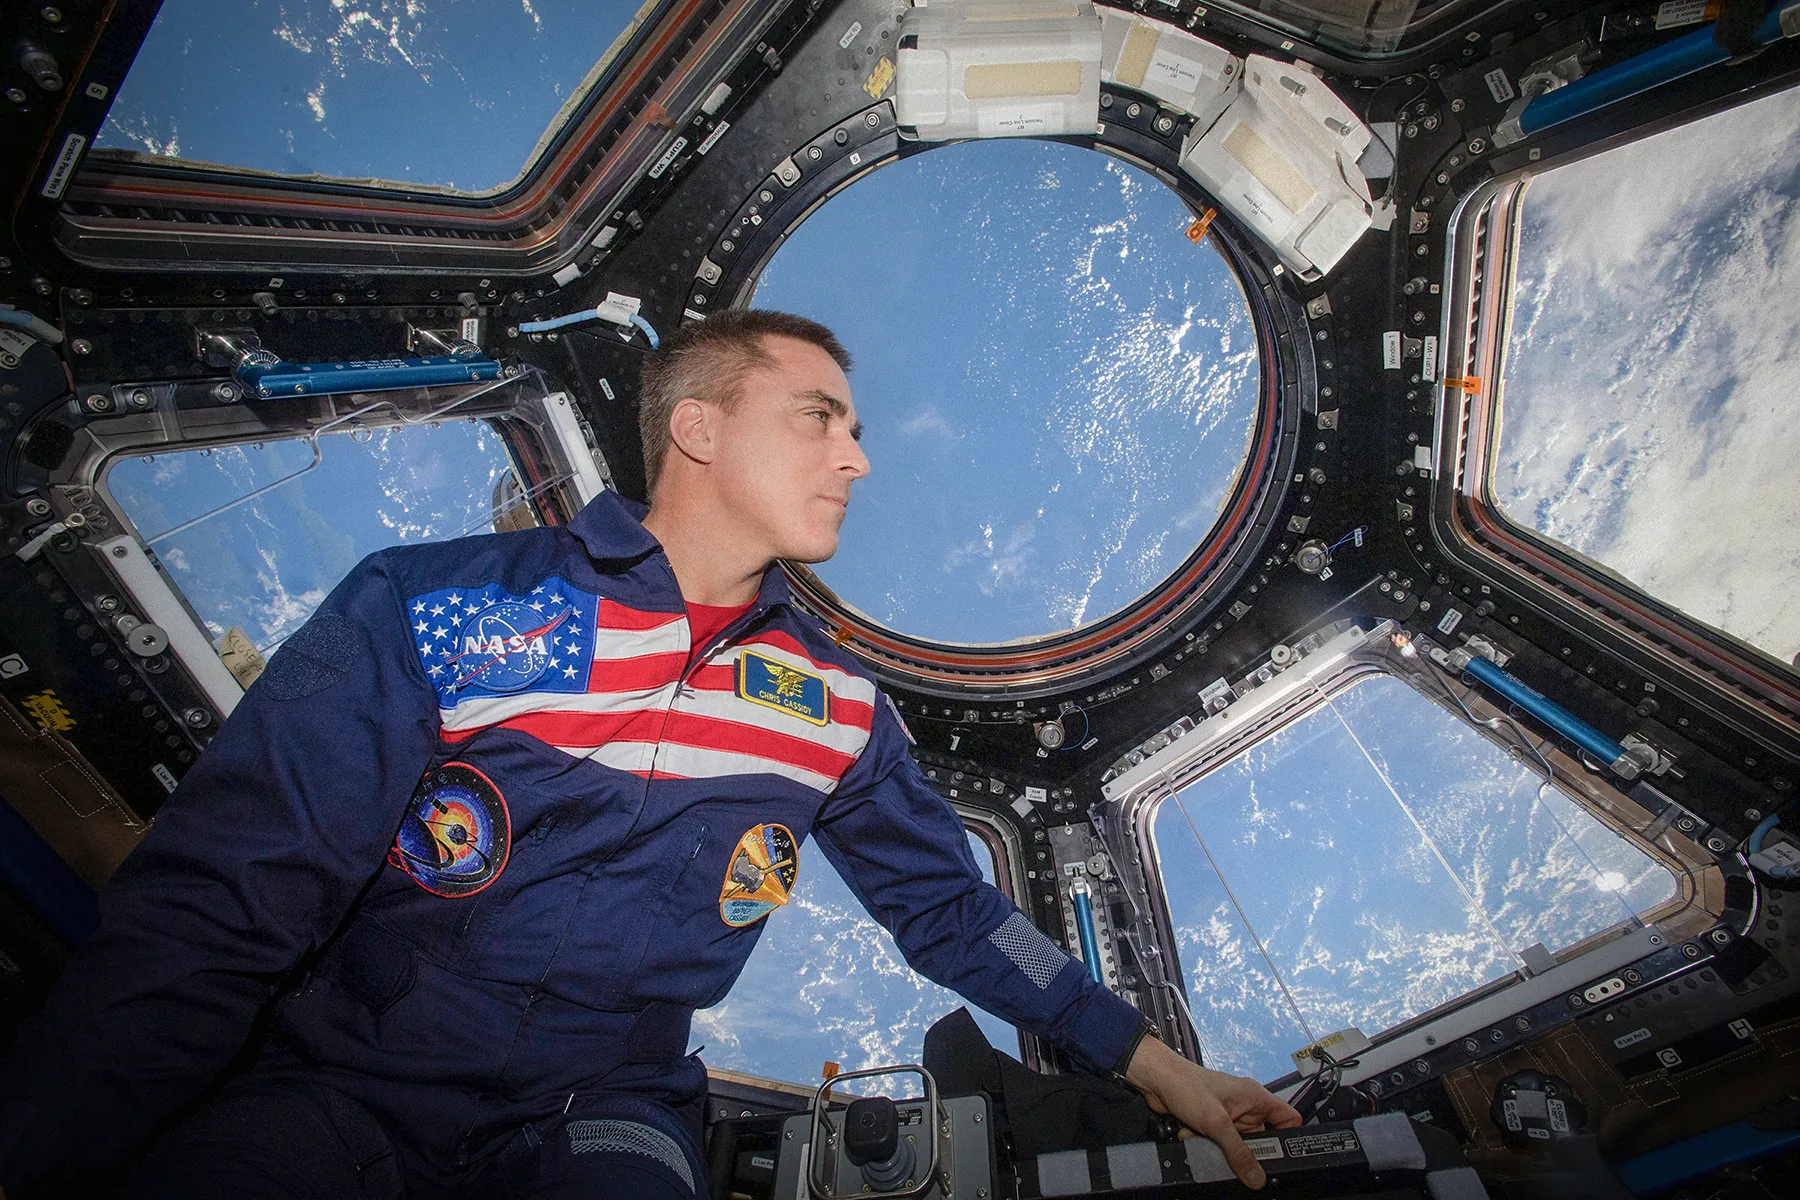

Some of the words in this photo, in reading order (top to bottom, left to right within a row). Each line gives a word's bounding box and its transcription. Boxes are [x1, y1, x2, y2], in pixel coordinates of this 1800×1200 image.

[870, 67, 886, 88] VACUUM
[705, 124, 726, 146] Window
[64, 137, 80, 162] Scratch
[653, 142, 683, 175] CUP1_W5
[55, 160, 70, 178] Pane
[50, 176, 62, 190] Win
[464, 635, 549, 655] NASA
[1, 658, 24, 674] C
[1203, 685, 1222, 699] Window
[759, 690, 780, 703] CHRIS
[783, 699, 812, 715] CASSIDY
[35, 702, 57, 727] VACUUM
[1633, 1033, 1643, 1041] Pnl
[1730, 1020, 1752, 1039] H
[1660, 1050, 1676, 1065] G
[1556, 1104, 1566, 1127] CLOSED
